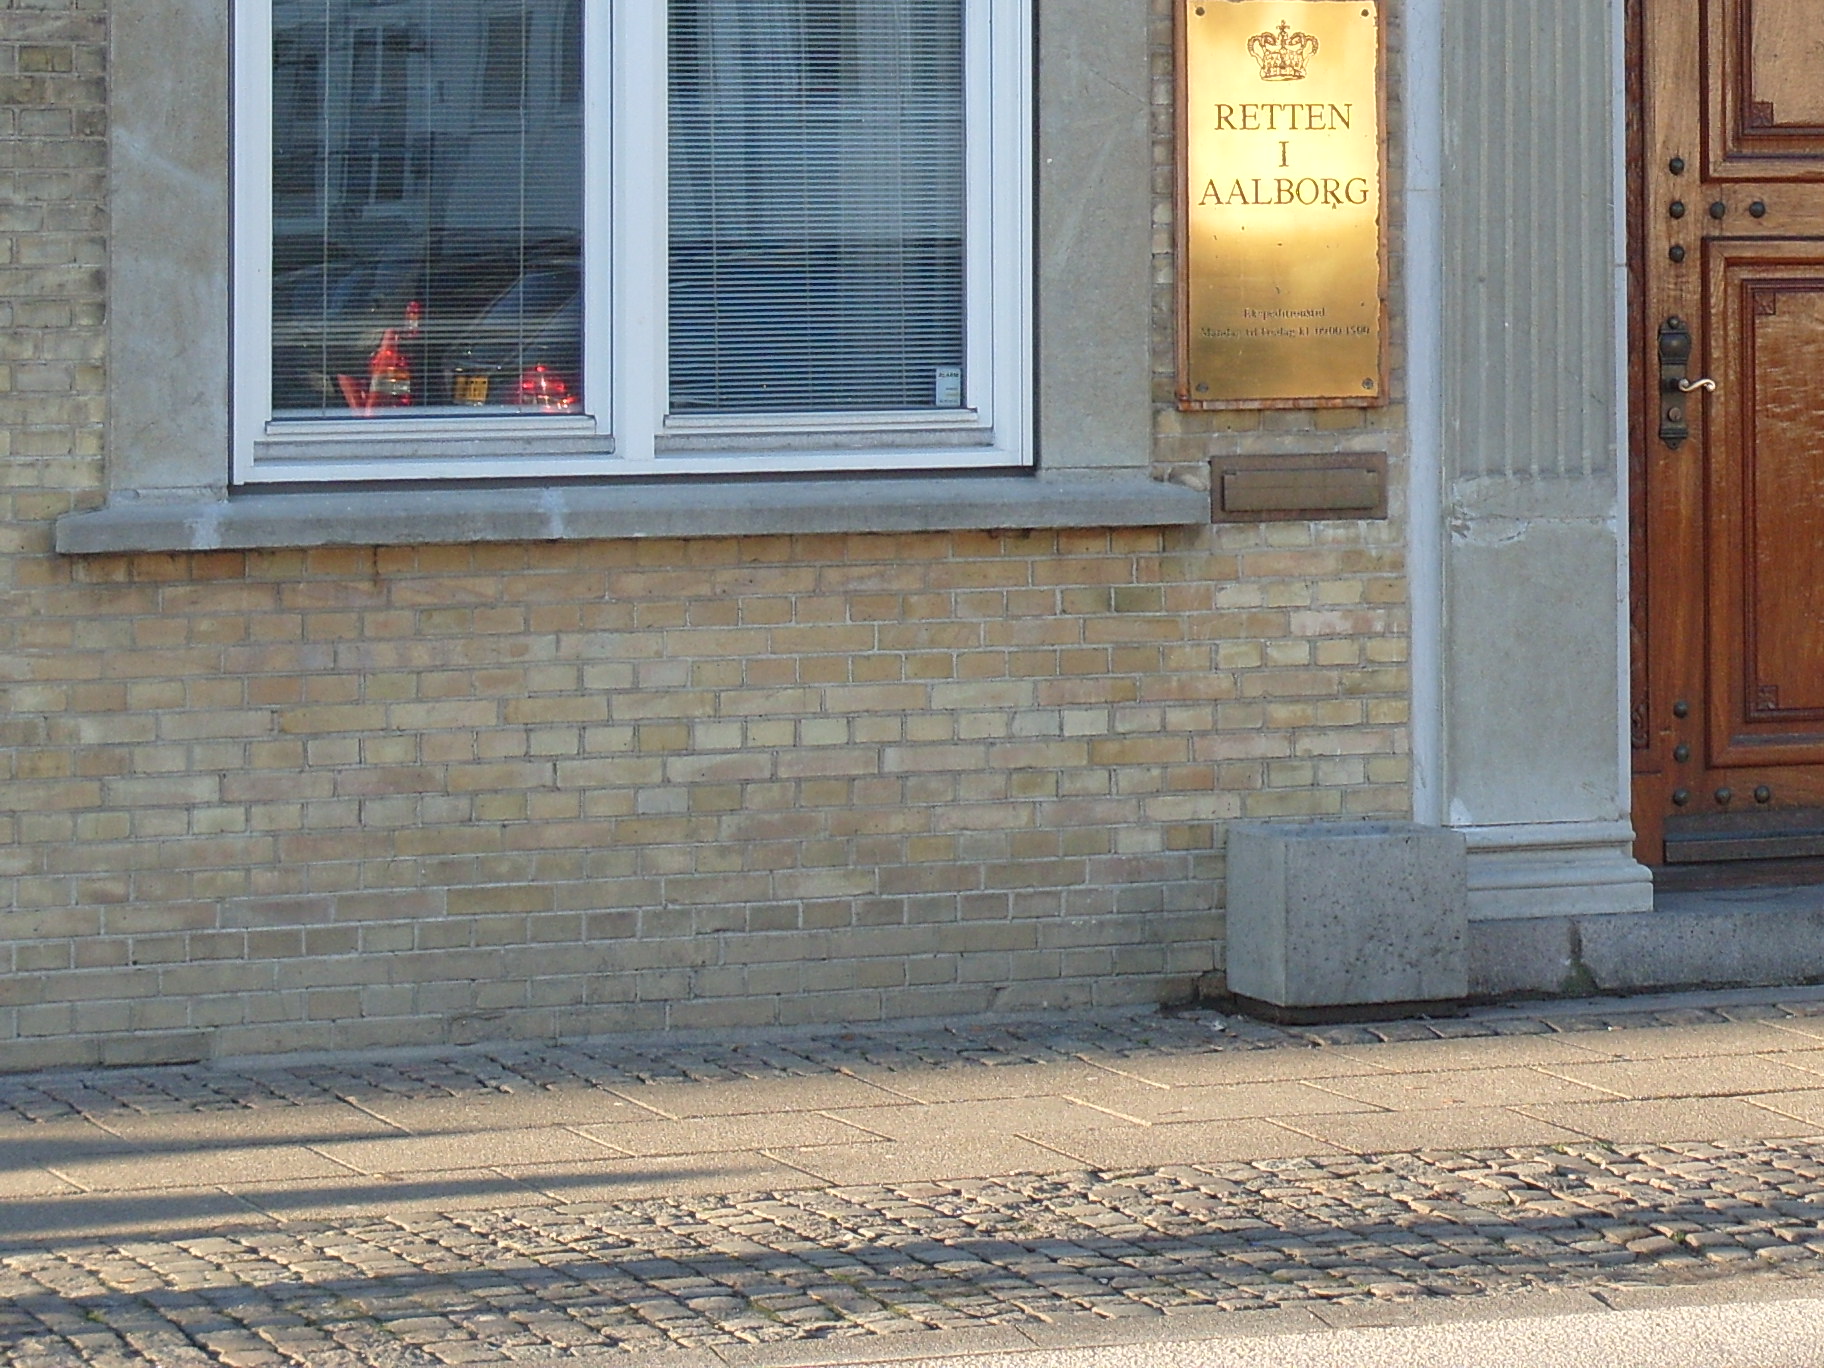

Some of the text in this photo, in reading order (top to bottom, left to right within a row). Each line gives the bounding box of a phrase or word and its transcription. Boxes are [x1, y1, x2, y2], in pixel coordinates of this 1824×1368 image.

[1213, 103, 1353, 131] RETTEN
[1278, 140, 1290, 168] I
[1197, 177, 1370, 206] AALBORG
